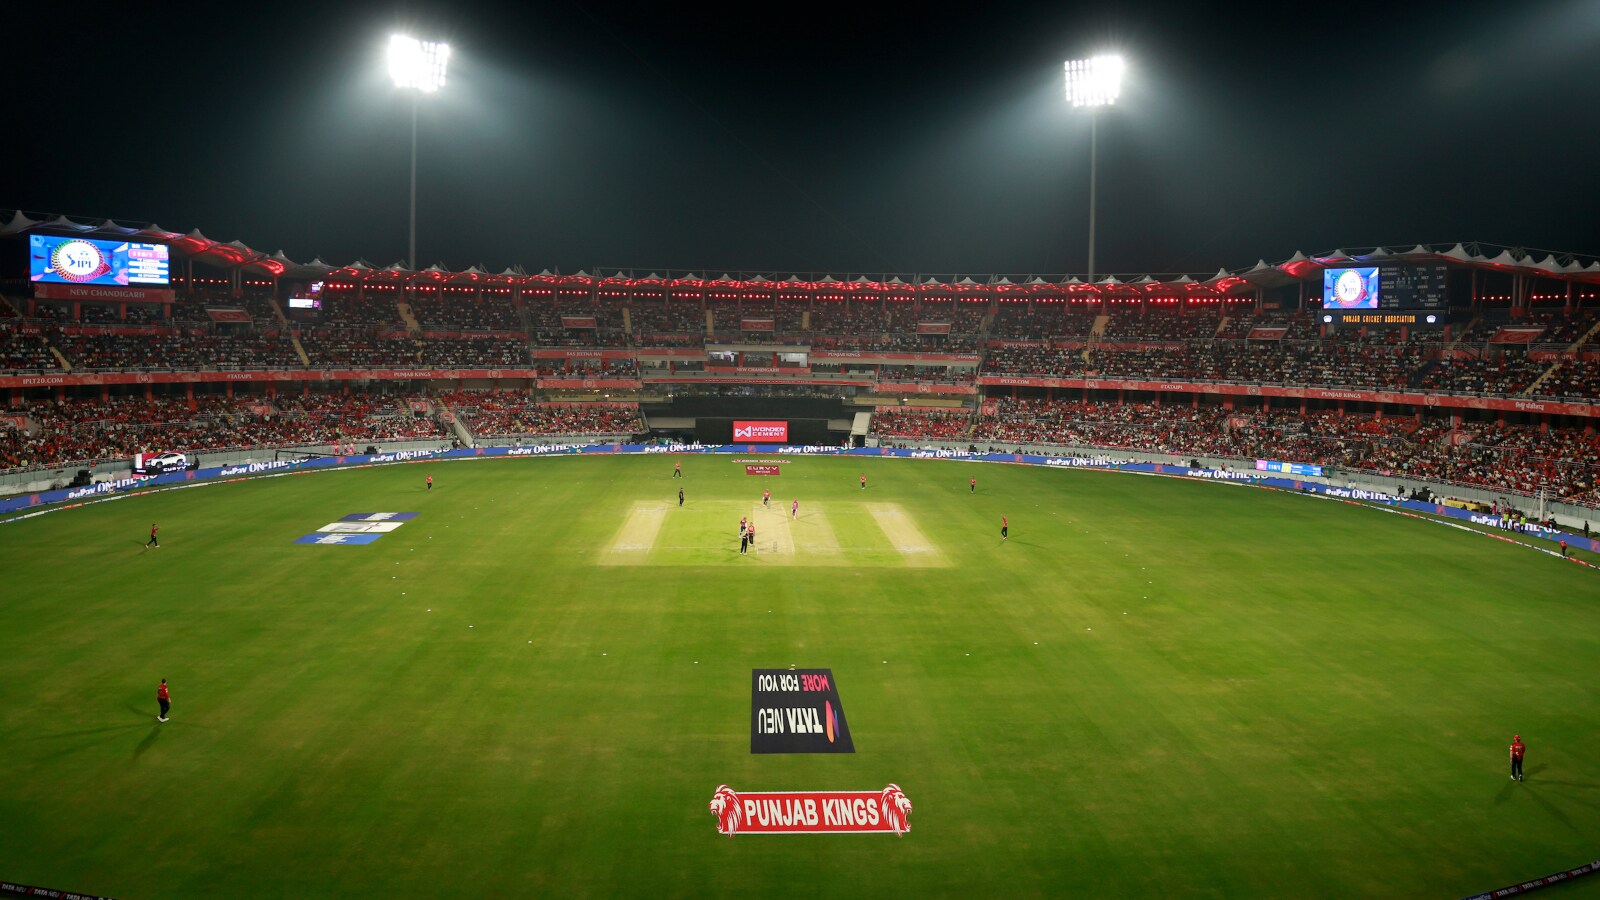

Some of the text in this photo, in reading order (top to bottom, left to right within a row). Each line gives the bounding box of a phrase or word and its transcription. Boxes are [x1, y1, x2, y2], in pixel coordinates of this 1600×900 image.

[91, 290, 145, 298] CHANDIGARH
[1343, 315, 1416, 323] PUNJAB CRICKET ASSOCIATION
[758, 674, 830, 692] MORE FOR YOU
[758, 708, 823, 734] TATA NEU
[744, 798, 880, 826] PUNJAB KINGS
